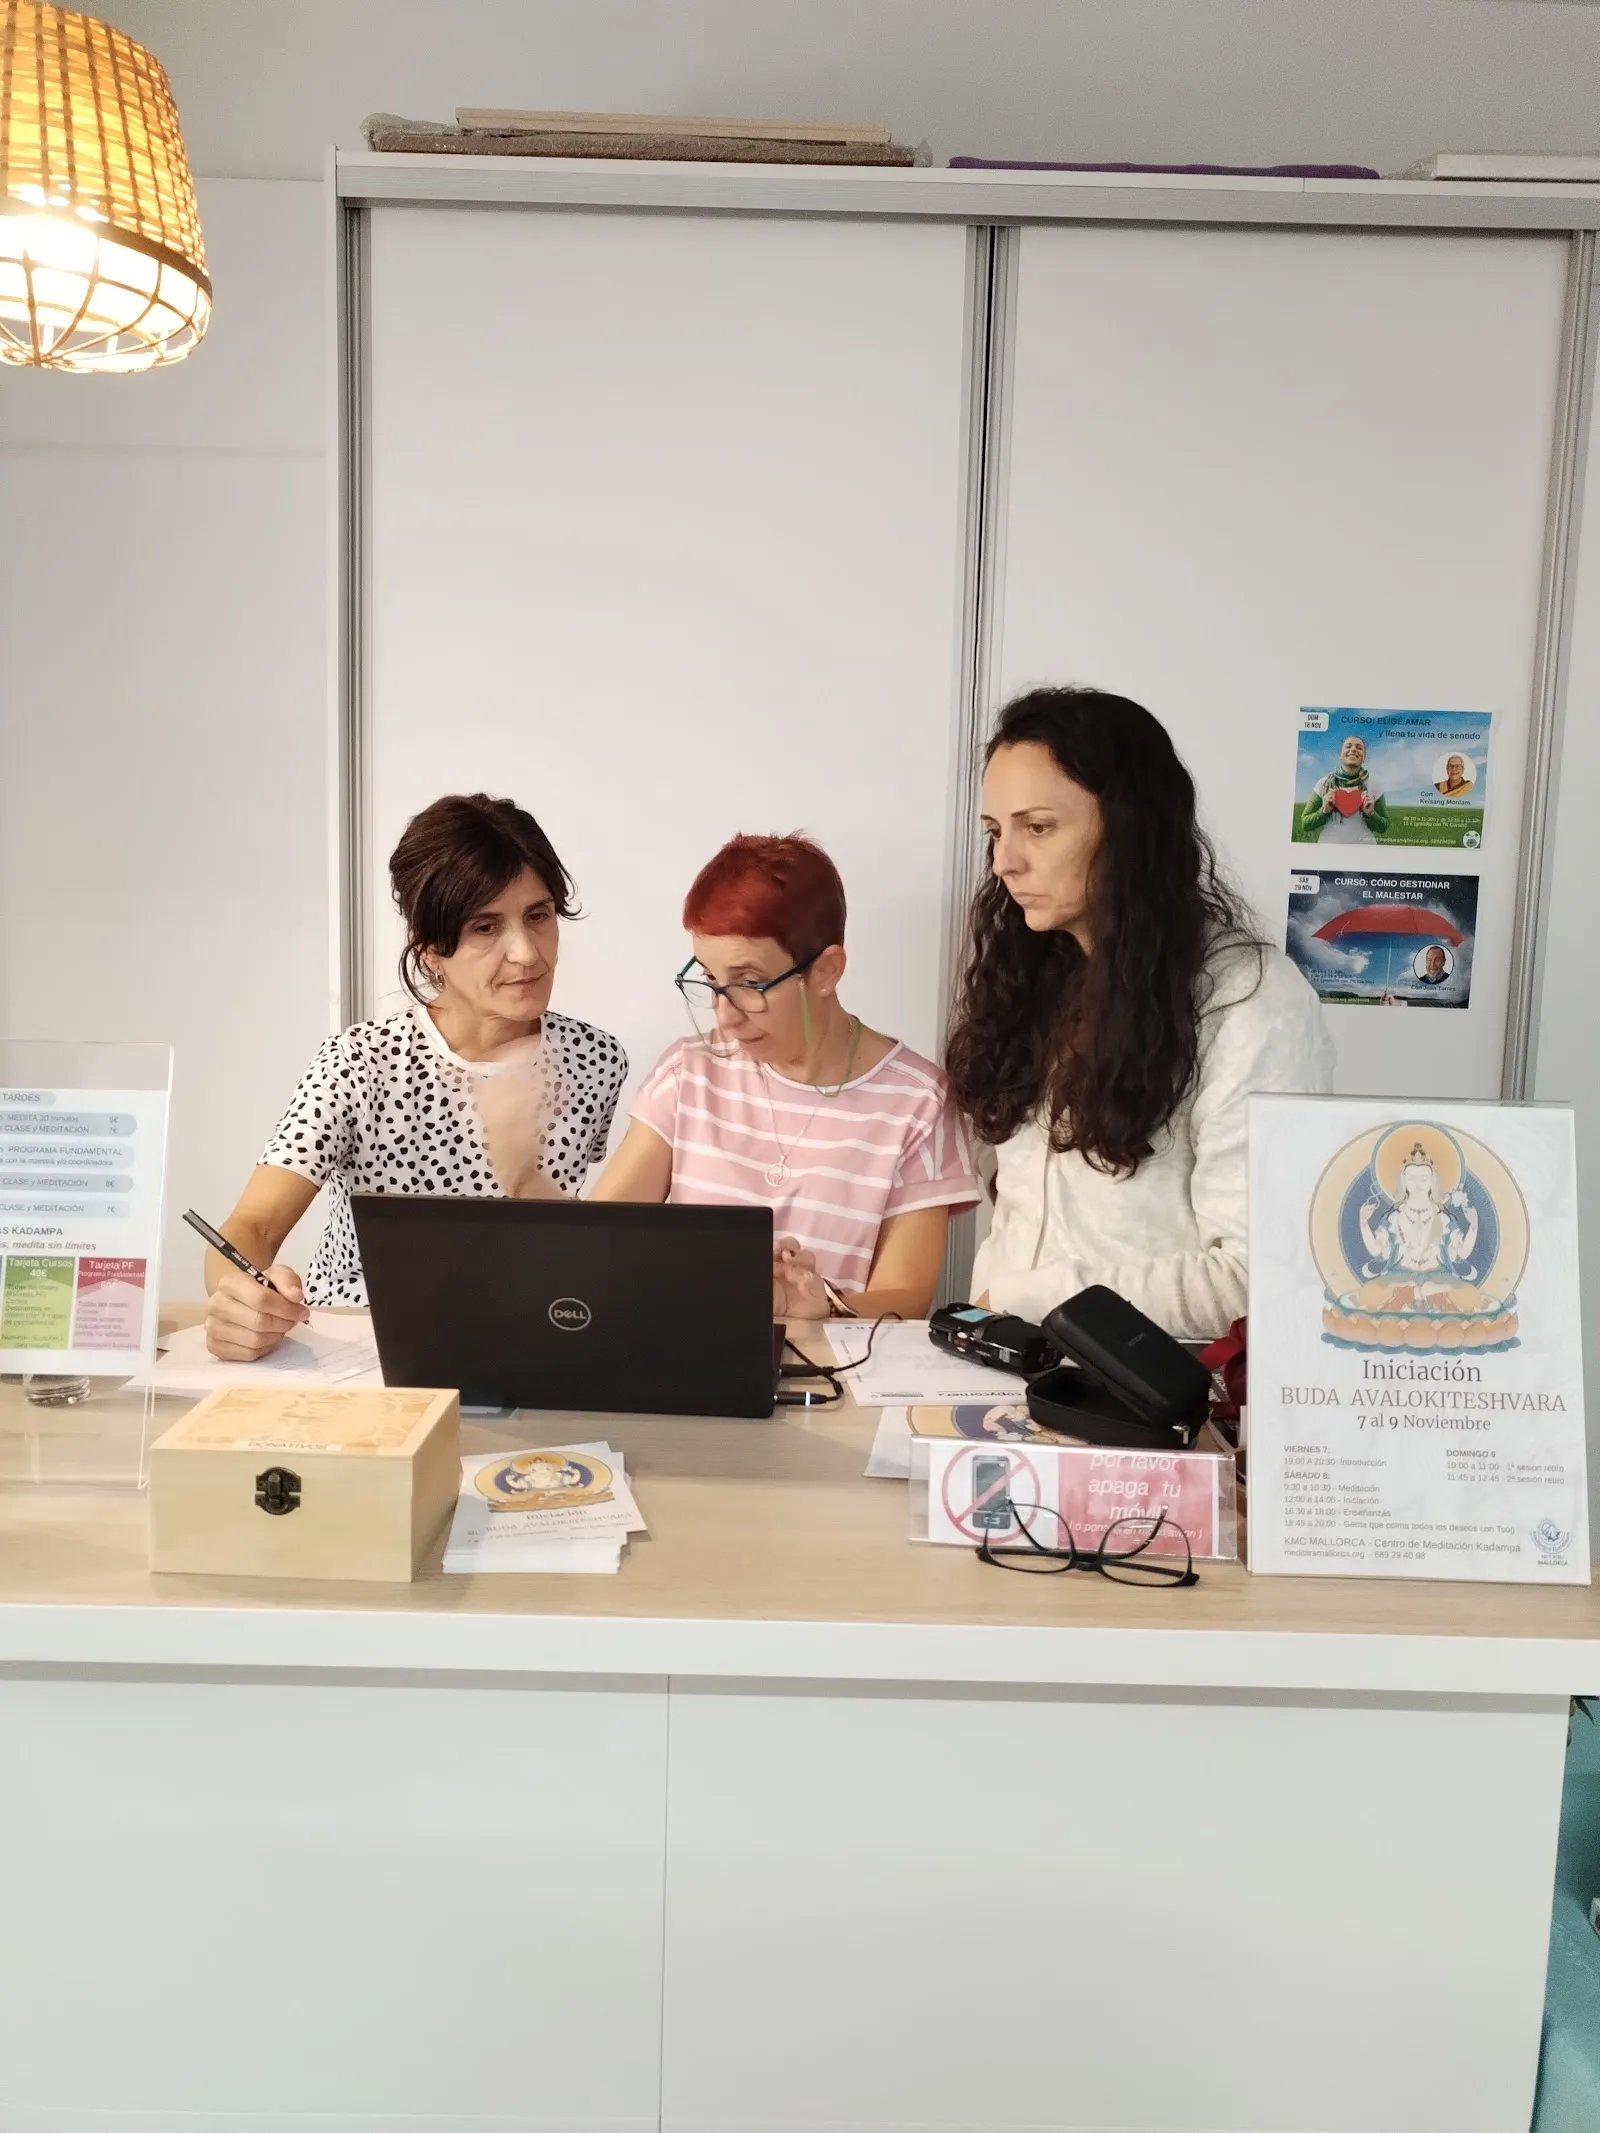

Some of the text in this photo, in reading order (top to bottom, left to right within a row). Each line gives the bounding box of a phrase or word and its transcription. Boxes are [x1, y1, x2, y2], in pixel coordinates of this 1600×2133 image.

[1341, 716, 1375, 725] CURSO:
[1377, 718, 1402, 726] ELIGE
[1385, 730, 1406, 738] llena
[1418, 731, 1435, 739] vida
[1437, 731, 1448, 739] de
[1449, 732, 1481, 740] sentido
[1334, 877, 1450, 889] CURSO: CÓMO GESTIONAR
[1363, 890, 1423, 900] EL MALESTAR
[2, 1093, 40, 1101] TARDES
[39, 1124, 89, 1133] MEDITACIÓN
[8, 1146, 122, 1155] PROGRAMA FUNDAMENTAL
[37, 1177, 88, 1186] MEDITACIÓN
[33, 1203, 84, 1212] MEDITACIÓN
[12, 1227, 63, 1235] KADAMPA
[12, 1240, 45, 1249] medita
[48, 1241, 62, 1249] sin
[9, 1258, 73, 1269] Tarjeta Cursos
[89, 1260, 135, 1270] Tarjeta PF
[554, 1309, 587, 1319] DELL
[1362, 1359, 1482, 1382] Iniciación
[1281, 1387, 1567, 1412] BUDA AVALOKITESHVARA
[1357, 1415, 1491, 1431] 7 al 9 Noviembre
[1284, 1445, 1321, 1453] VIERNES
[1446, 1449, 1489, 1458] DOMINGO
[1090, 1455, 1125, 1470] por
[1315, 1458, 1336, 1466] 20:30
[1340, 1458, 1387, 1467] Introducción
[1544, 1464, 1564, 1473] retiro
[1284, 1470, 1321, 1479] SÁBADO
[1544, 1476, 1565, 1485] retiro
[1088, 1478, 1182, 1498] apaga tu
[1339, 1484, 1380, 1493] Meditación
[1343, 1496, 1380, 1505] Iniciación
[1343, 1508, 1391, 1517] Enseñanzas
[1369, 1522, 1384, 1531] que
[1411, 1521, 1433, 1531] todos
[1435, 1522, 1447, 1531] los
[1449, 1523, 1478, 1532] deseos
[1480, 1525, 1494, 1533] con
[1284, 1537, 1520, 1553] KMC MALLORCA Centro de Meditación Kadampa
[1374, 1550, 1389, 1559] 689
[1403, 1551, 1413, 1560] 40
